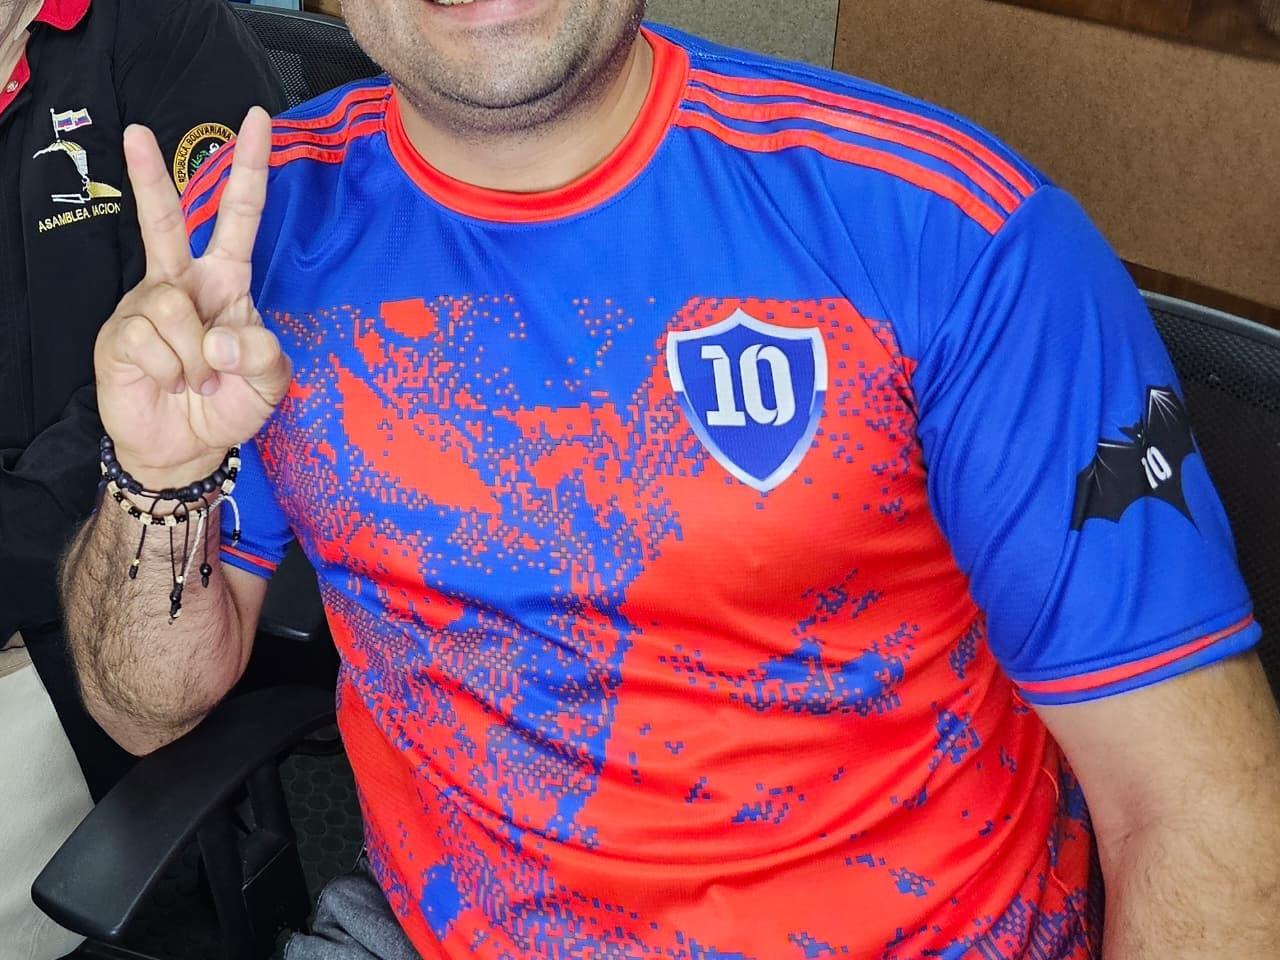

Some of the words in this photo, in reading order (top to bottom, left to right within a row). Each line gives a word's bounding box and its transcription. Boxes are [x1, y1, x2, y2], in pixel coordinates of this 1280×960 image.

[186, 125, 232, 146] BOLIVARIANA
[38, 207, 91, 233] ASAMBLEA
[701, 343, 796, 427] 10
[1141, 446, 1173, 490] 10
